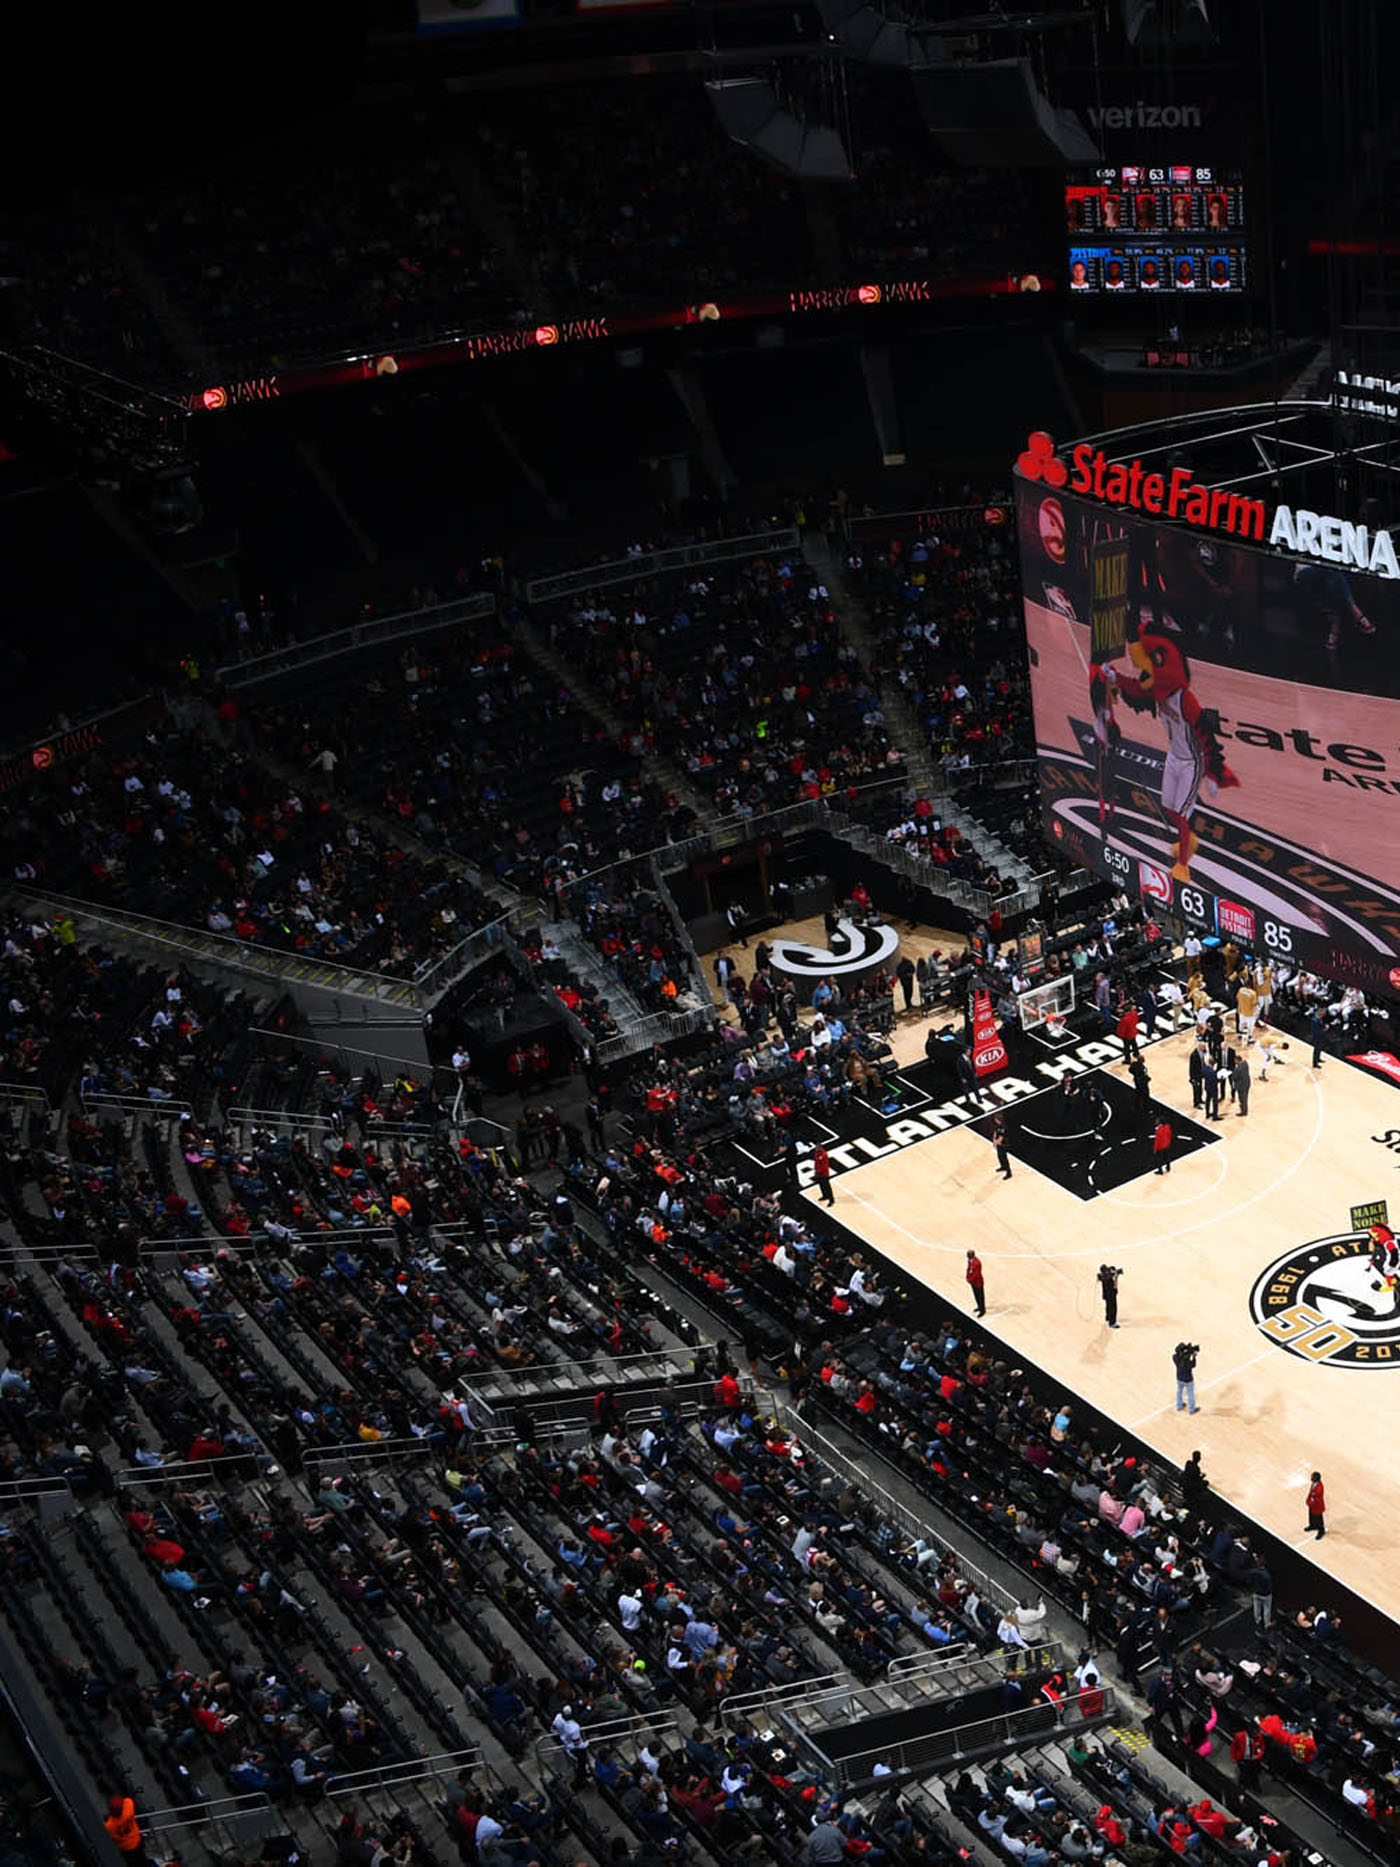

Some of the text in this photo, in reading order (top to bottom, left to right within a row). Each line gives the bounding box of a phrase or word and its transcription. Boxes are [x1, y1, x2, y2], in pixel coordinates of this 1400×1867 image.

[1088, 101, 1201, 129] verizon
[1149, 168, 1164, 180] 63
[1196, 168, 1211, 180] 85
[1269, 504, 1400, 579] ARENA
[1104, 846, 1130, 874] 6:50
[1112, 872, 1126, 888] 3RD
[1181, 887, 1205, 917] 63
[1219, 906, 1252, 928] DETROIT
[1264, 921, 1293, 952] 85
[1353, 1202, 1385, 1218] MAKE
[1268, 1267, 1306, 1305] 1968
[1259, 1304, 1358, 1362] 50
